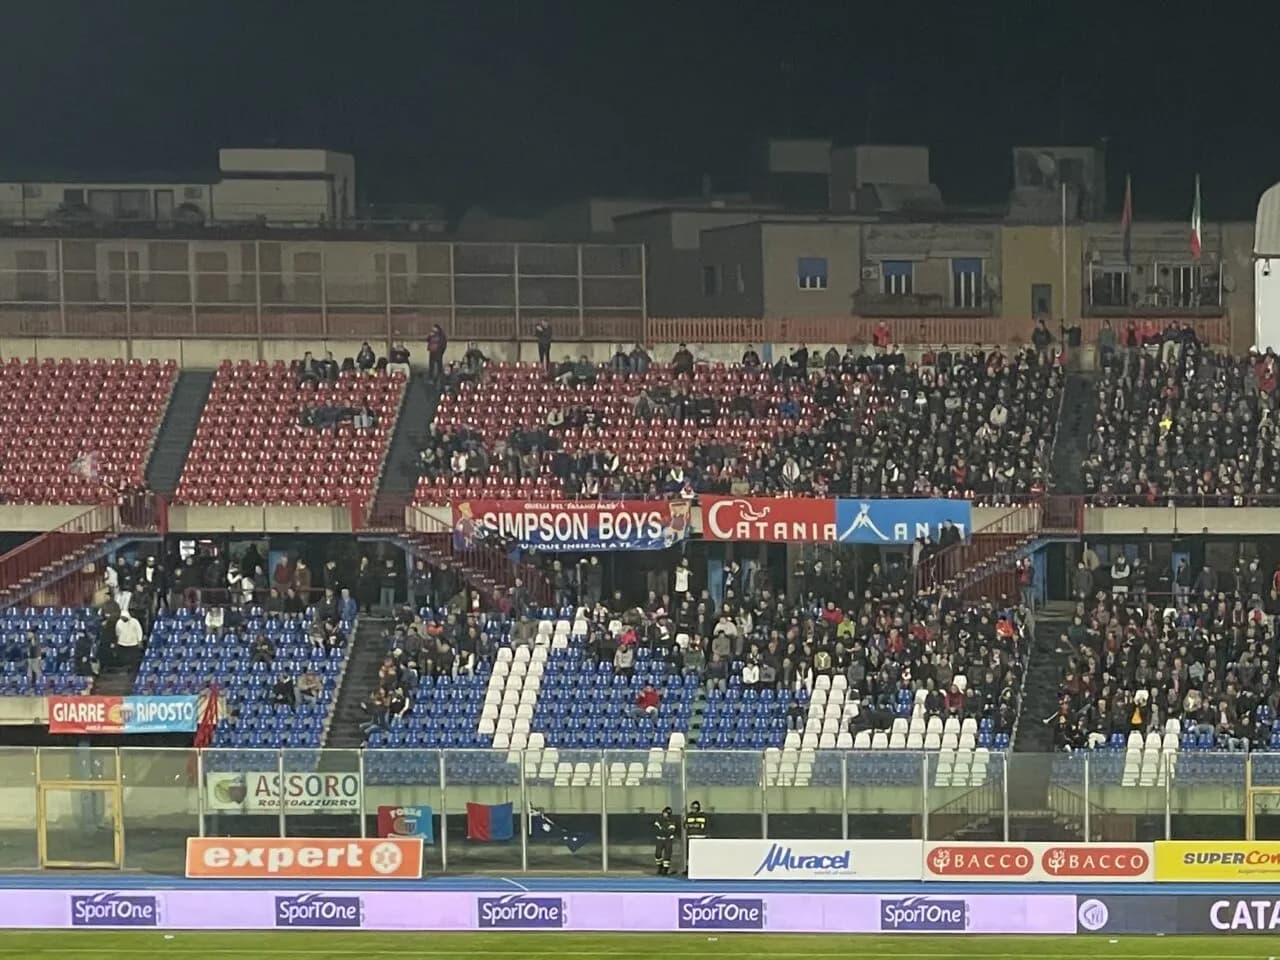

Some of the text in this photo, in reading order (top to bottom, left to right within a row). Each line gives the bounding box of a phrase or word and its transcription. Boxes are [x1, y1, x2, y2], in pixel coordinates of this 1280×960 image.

[483, 511, 663, 542] SIMPSON BOYS
[708, 500, 837, 540] CATANIA
[53, 702, 194, 723] GIARRE RIPOSTO
[255, 774, 359, 798] ASSORO
[203, 843, 363, 872] expert
[754, 843, 851, 876] Muracel
[955, 854, 1029, 868] BACCO
[1069, 855, 1144, 869] BACCO
